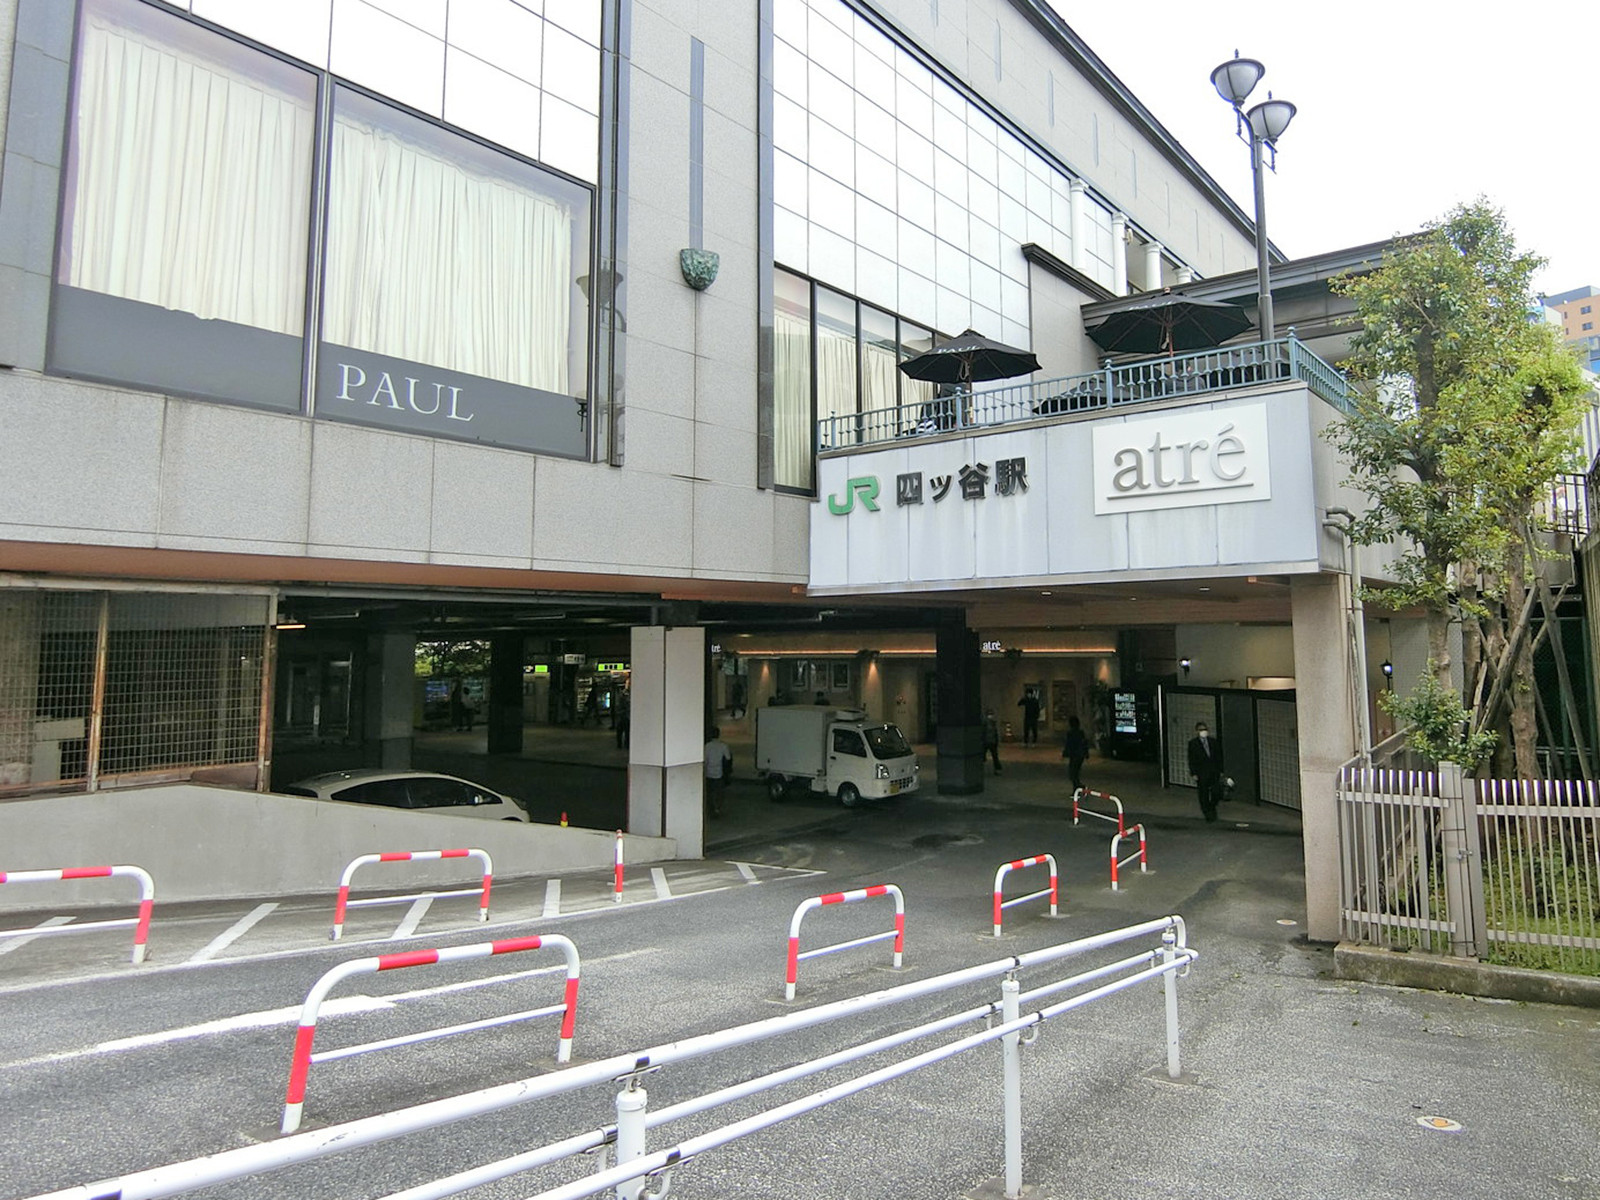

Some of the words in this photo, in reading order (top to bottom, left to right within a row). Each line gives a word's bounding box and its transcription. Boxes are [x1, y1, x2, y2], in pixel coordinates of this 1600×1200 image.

[336, 363, 474, 422] PAUL
[828, 475, 881, 515] JR
[896, 457, 1030, 507] 四ツ谷駅
[1112, 423, 1247, 492] atré
